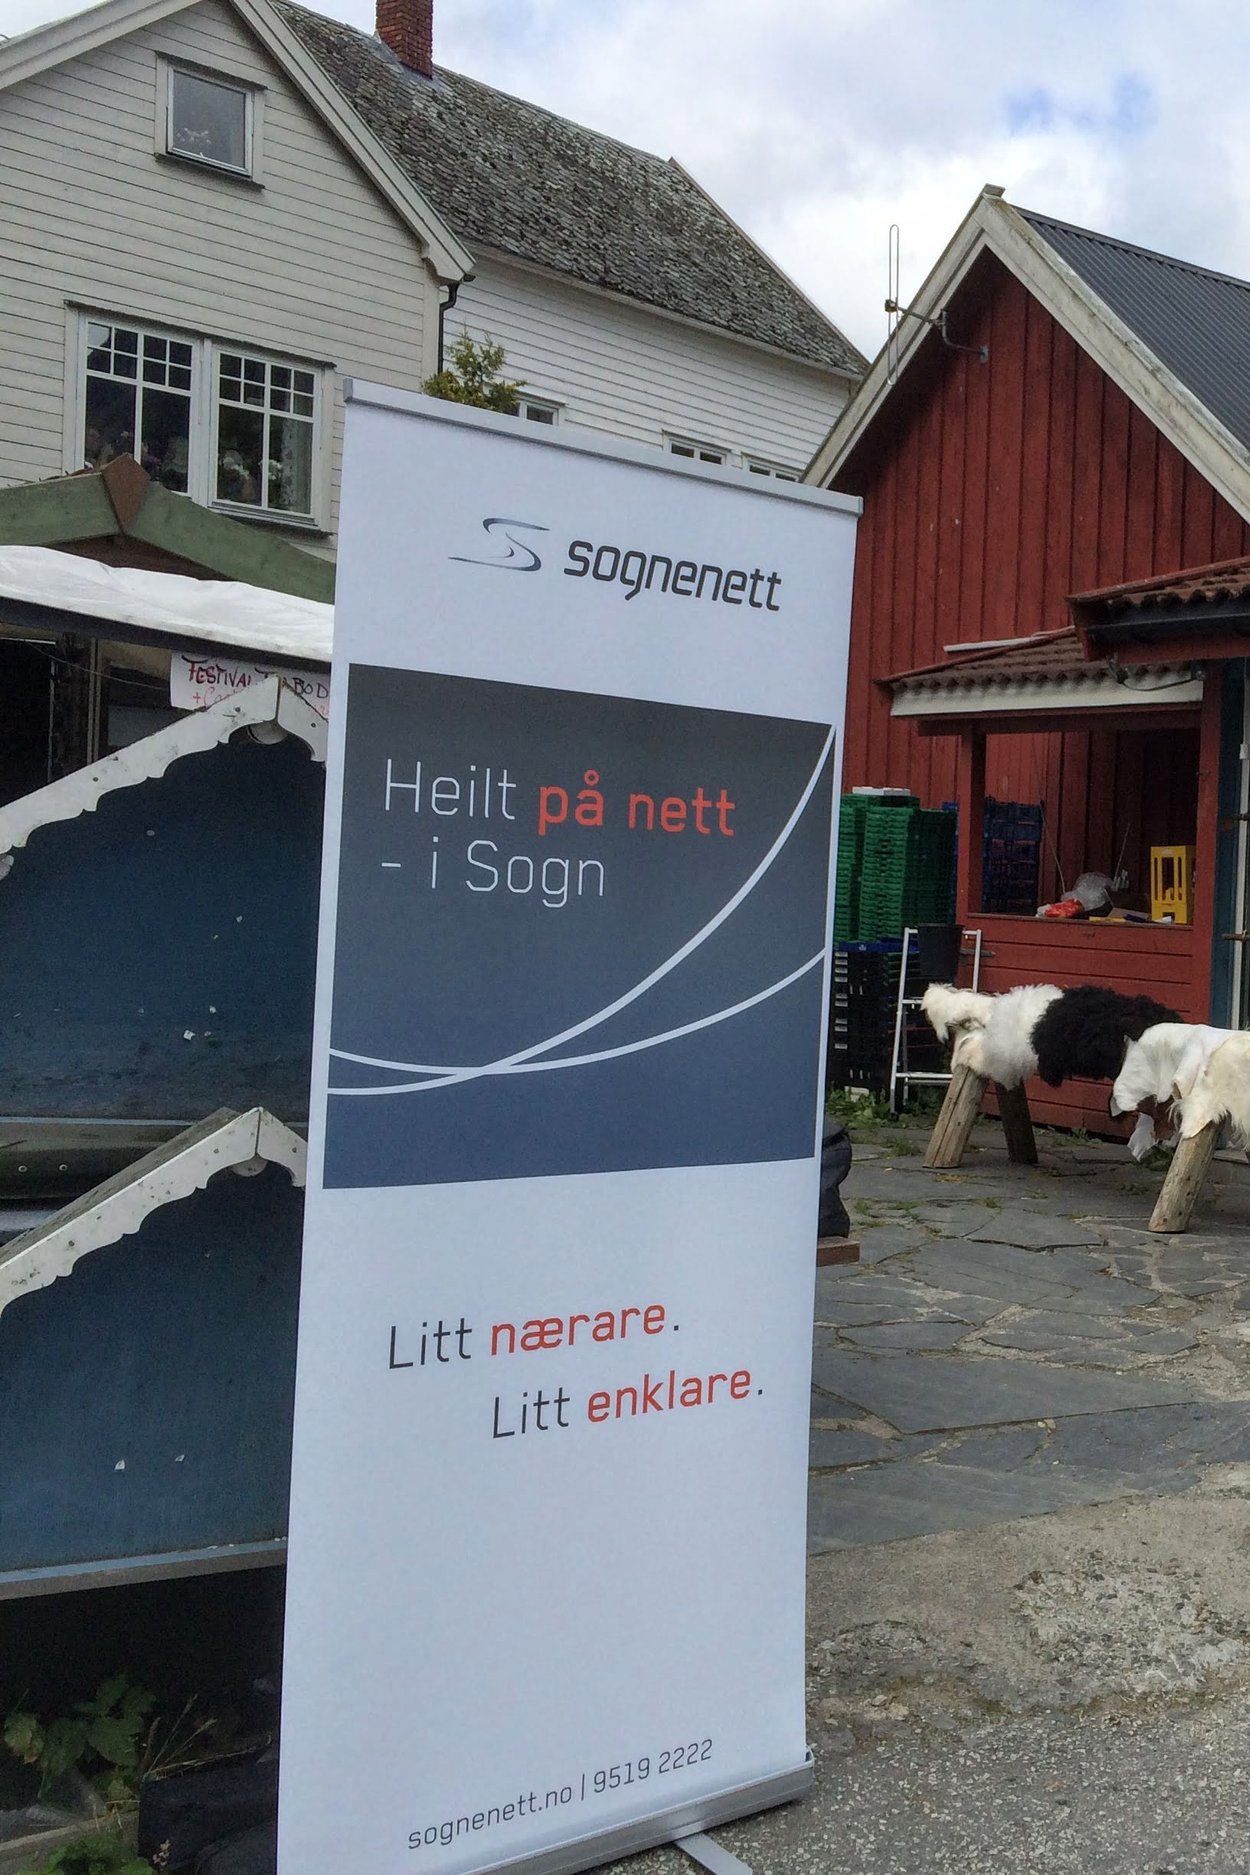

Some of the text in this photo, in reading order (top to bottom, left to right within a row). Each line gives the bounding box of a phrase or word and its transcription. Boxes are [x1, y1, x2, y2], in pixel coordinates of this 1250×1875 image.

[563, 540, 782, 612] sognenett
[385, 758, 735, 837] Heilt på nett
[431, 836, 439, 889] i
[465, 839, 604, 908] Sogn
[389, 1303, 681, 1370] Litt nærare.
[492, 1369, 764, 1439] Litt enklare.
[408, 1785, 573, 1850] sognenett.no
[593, 1757, 651, 1795] 9519
[658, 1738, 714, 1775] 2222
